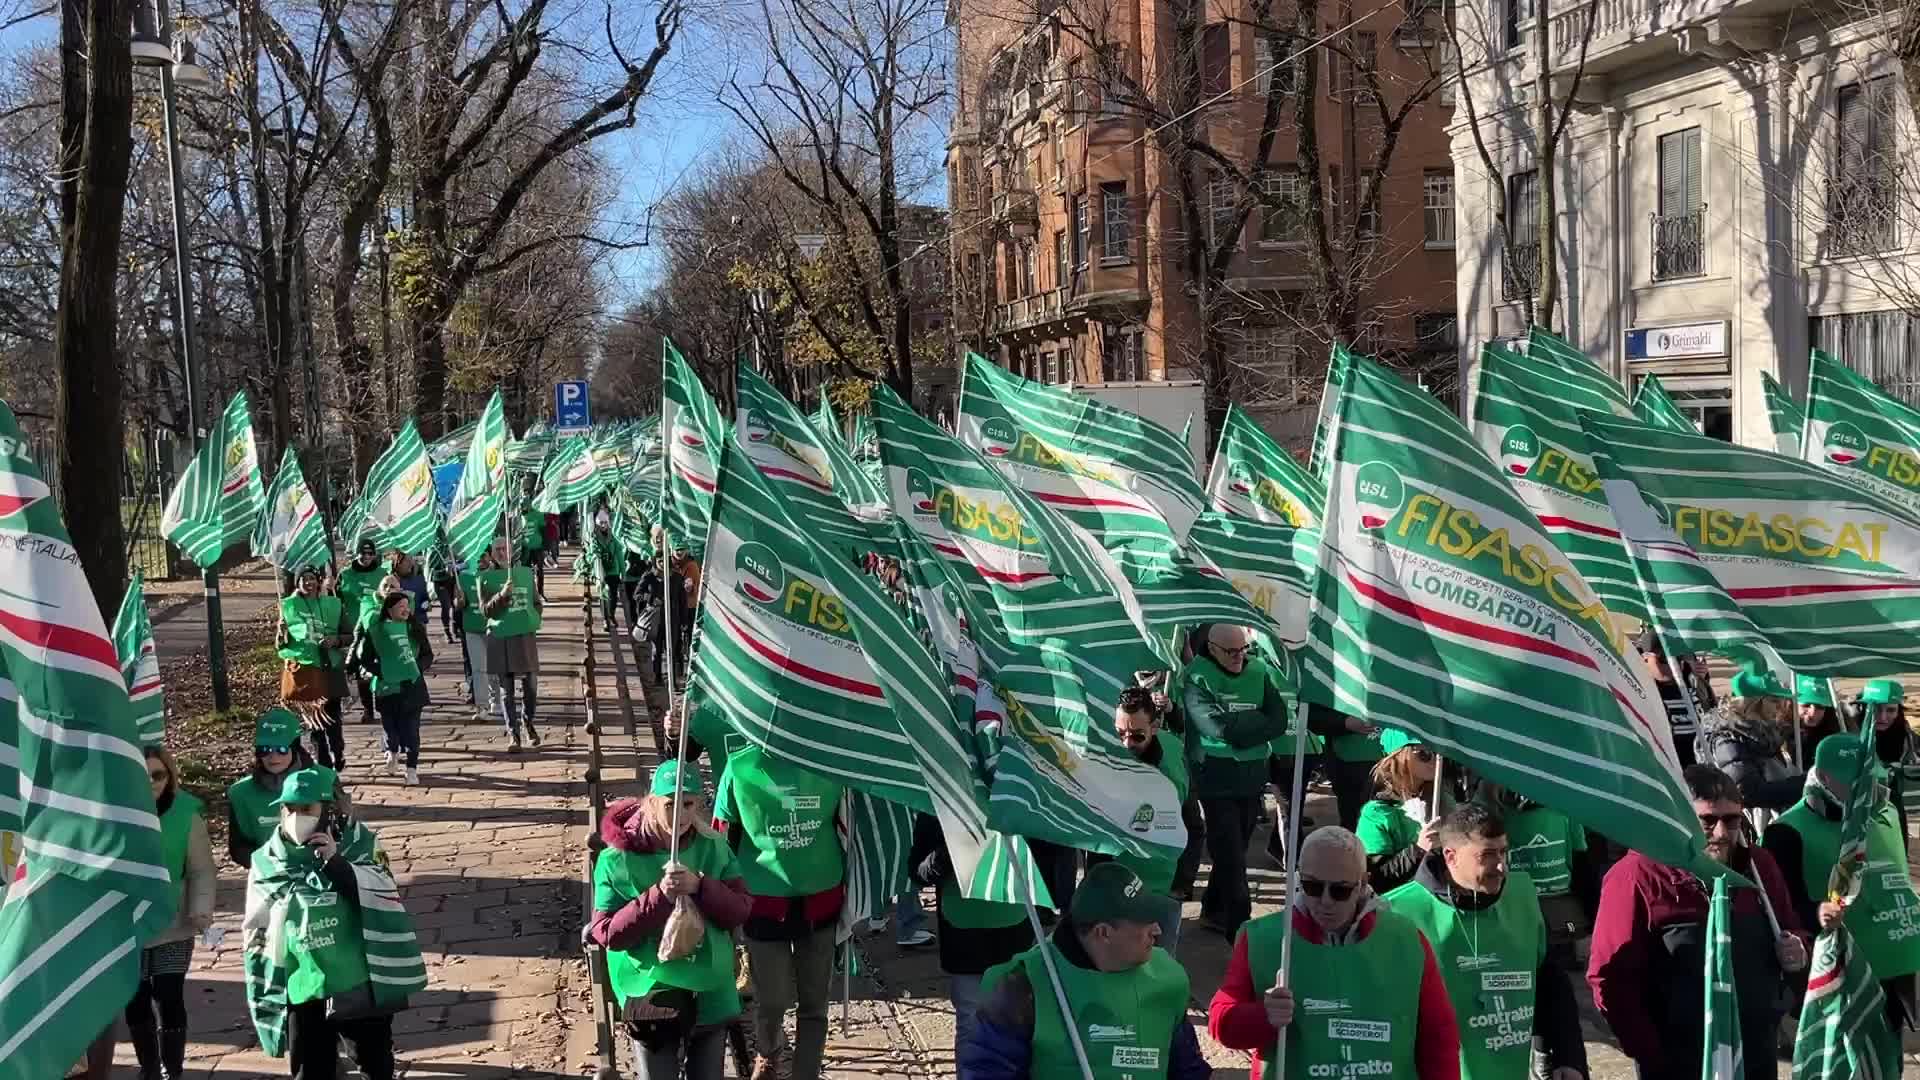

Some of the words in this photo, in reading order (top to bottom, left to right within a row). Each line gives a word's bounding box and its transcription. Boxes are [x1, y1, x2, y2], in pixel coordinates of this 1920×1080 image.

[1672, 329, 1711, 346] Grimaldi
[563, 384, 580, 406] P
[1509, 439, 1529, 452] CISL
[1675, 506, 1889, 564] FISASCAT
[744, 555, 773, 581] CISL
[1398, 494, 1625, 657] FISASCA
[1411, 569, 1557, 642] LOMBARDIA
[1309, 1059, 1392, 1077] contratto
